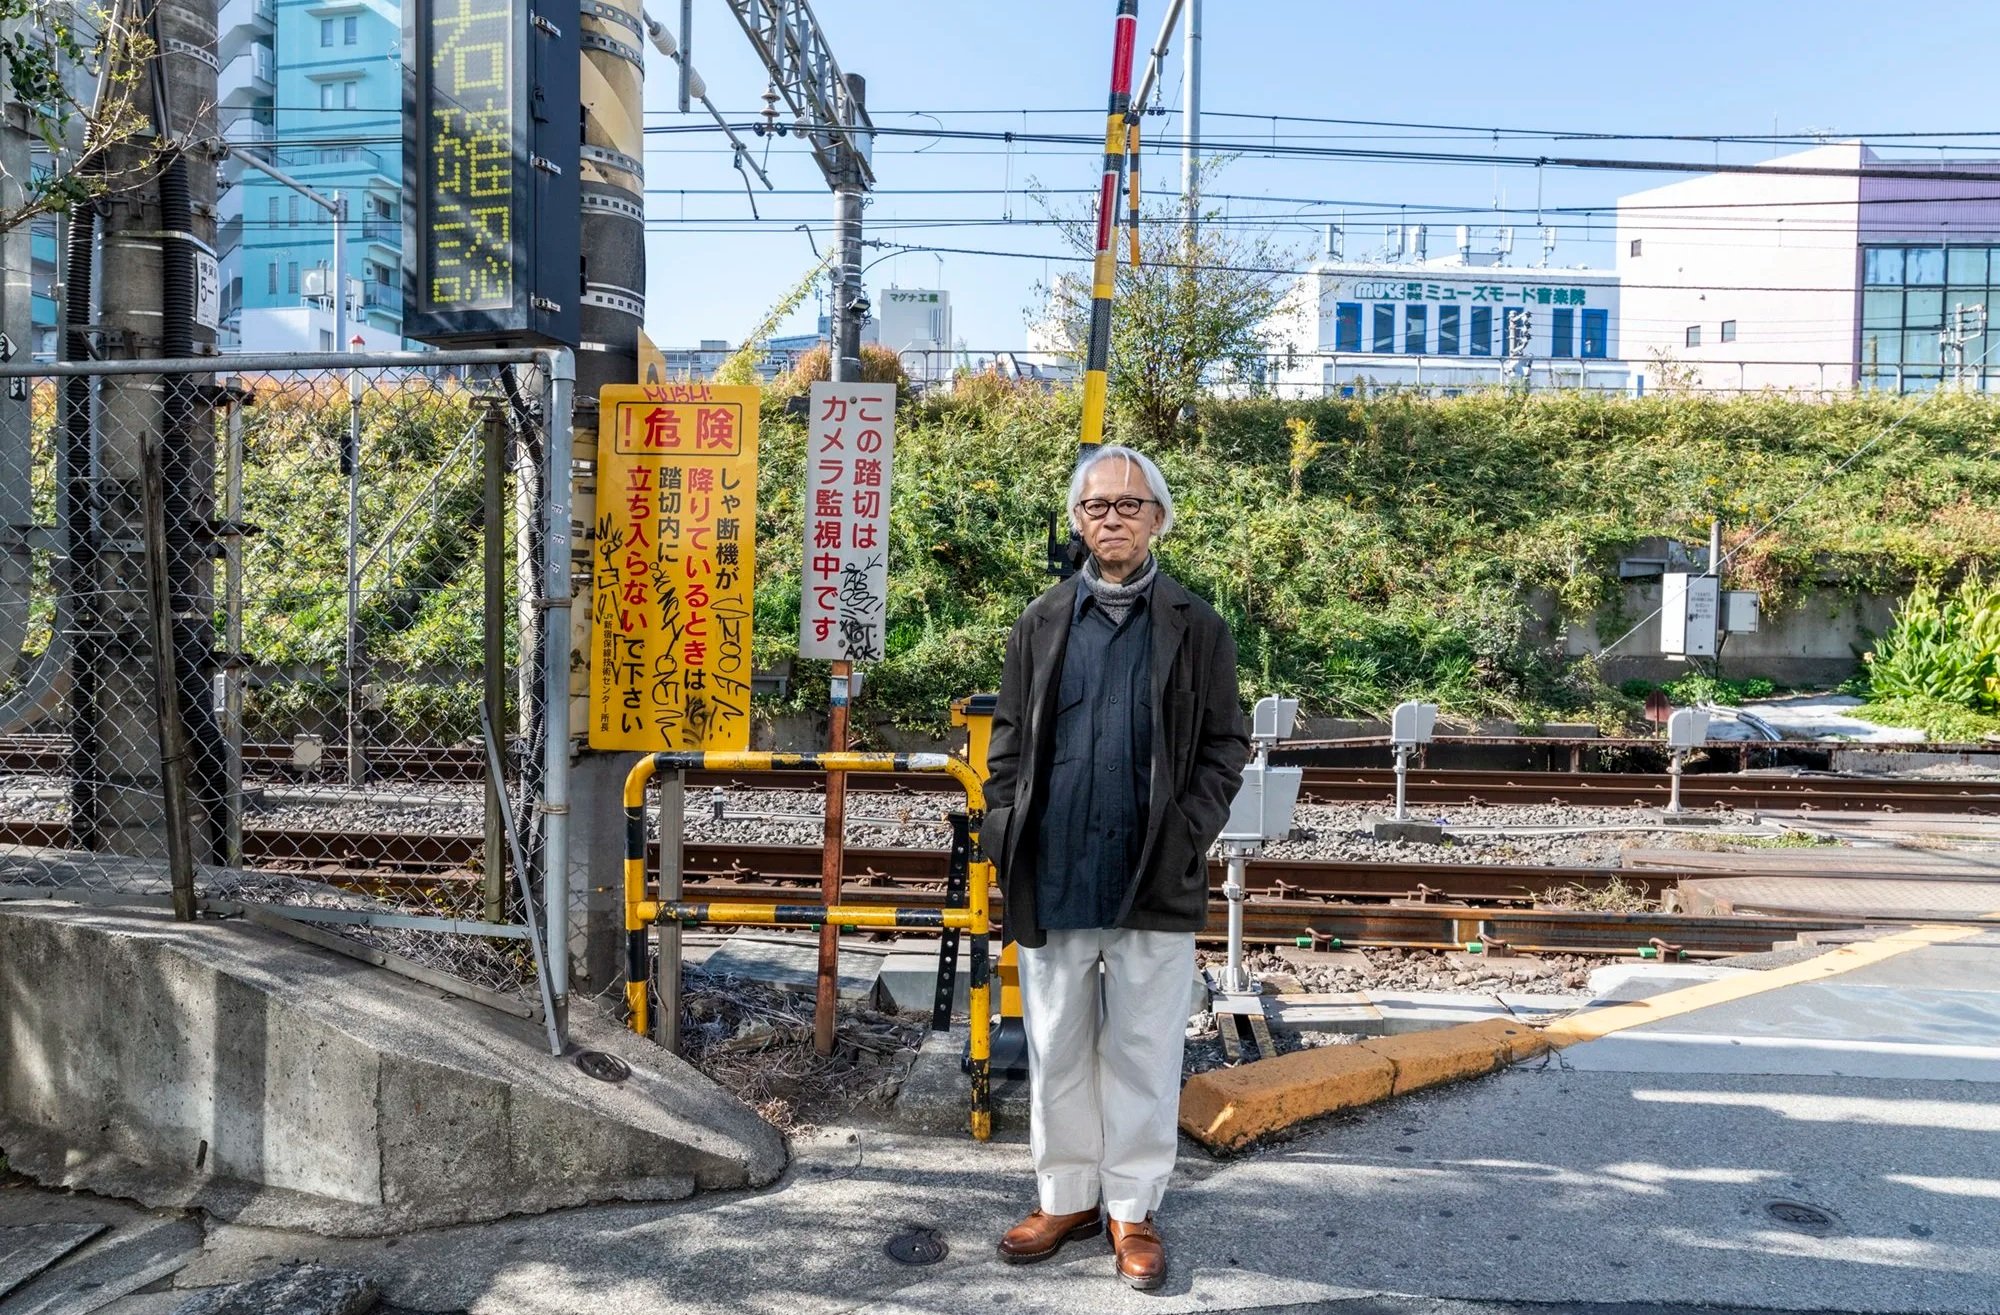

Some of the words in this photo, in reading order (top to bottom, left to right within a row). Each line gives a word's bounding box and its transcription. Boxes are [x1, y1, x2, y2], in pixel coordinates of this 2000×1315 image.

[656, 466, 682, 564] 踏切内に
[683, 467, 714, 691] 降りているときは
[811, 395, 847, 643] カメラ監視中です
[852, 396, 883, 550] この踏切は
[621, 464, 652, 735] 立ち入らないで下さい
